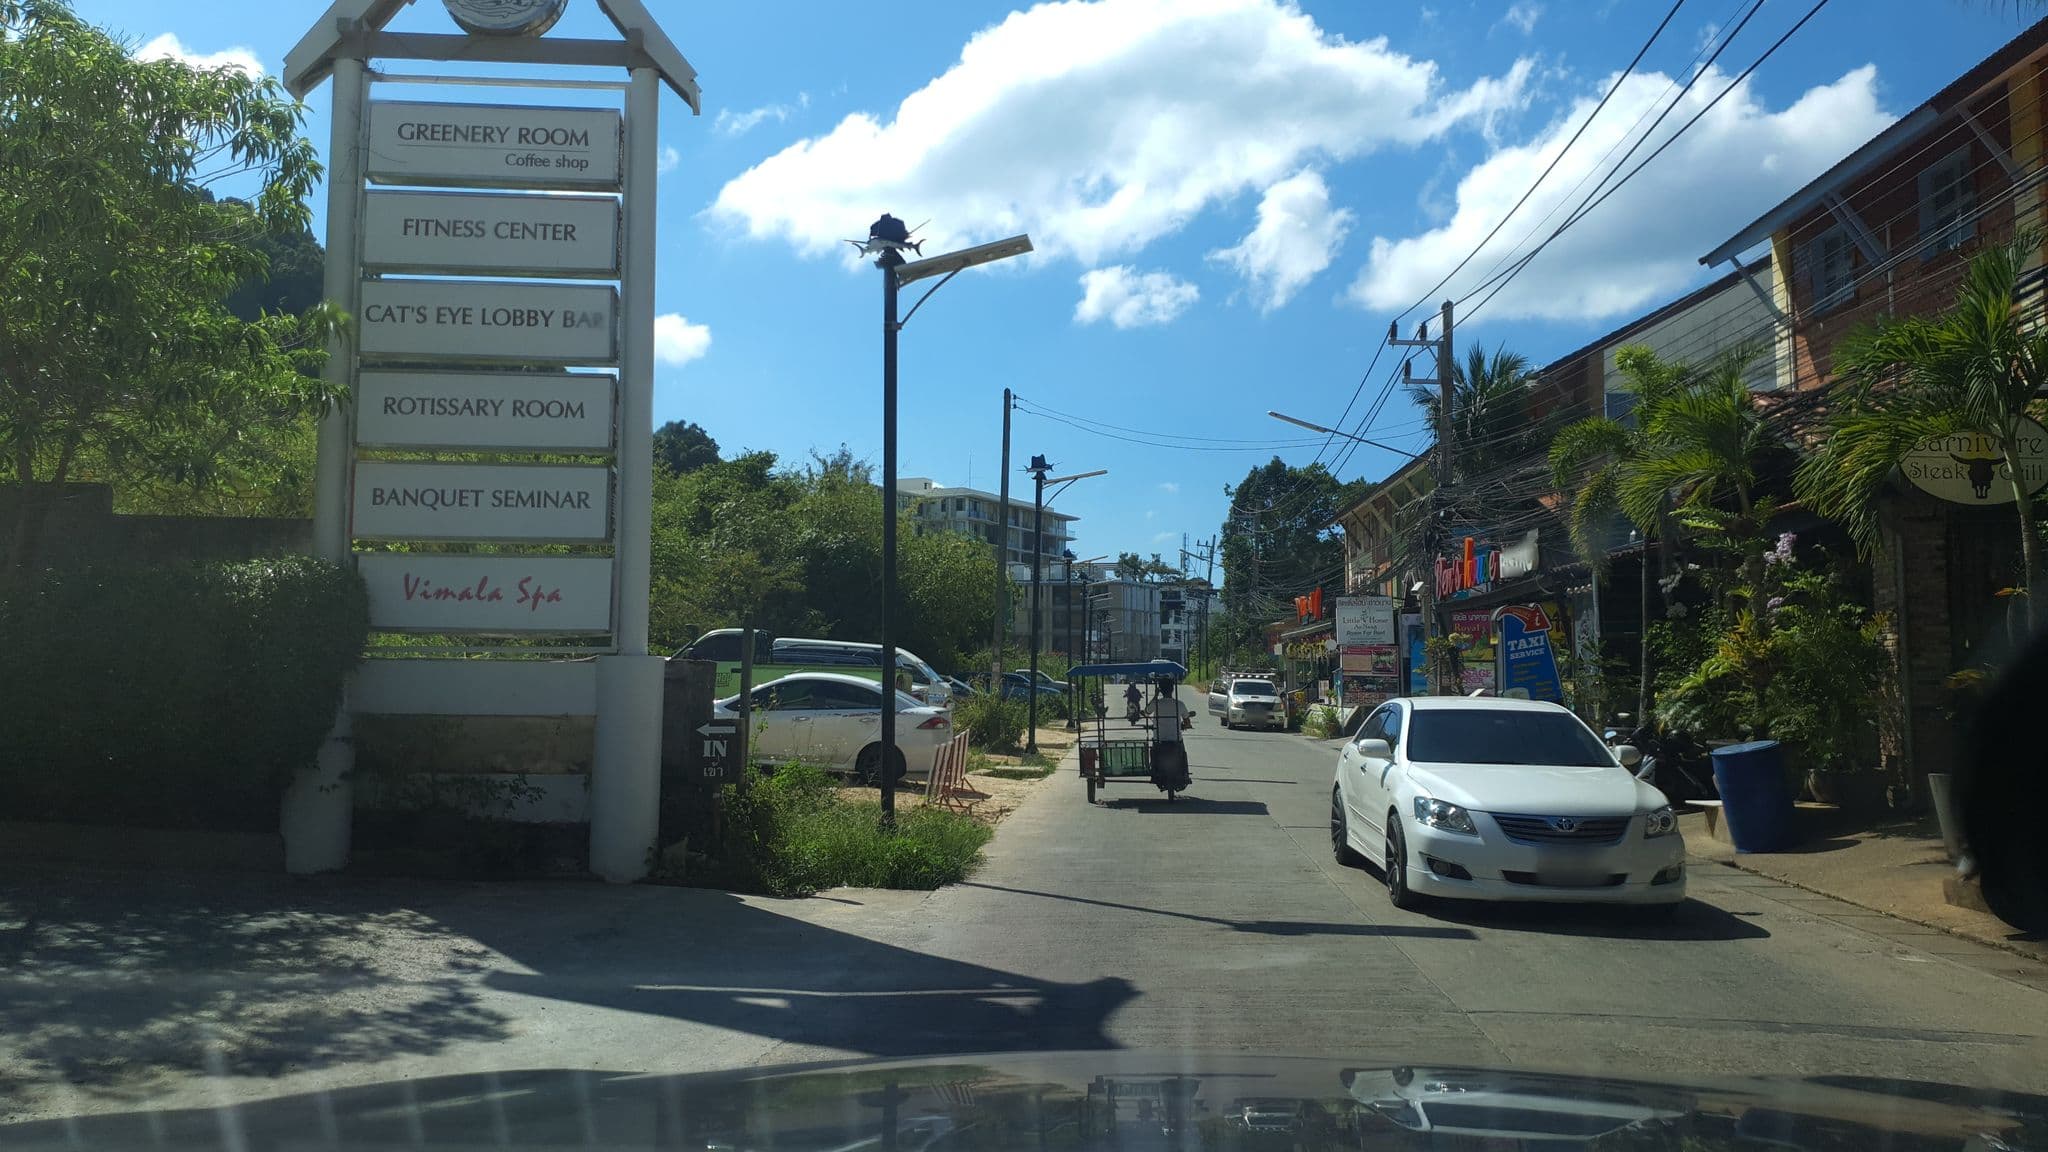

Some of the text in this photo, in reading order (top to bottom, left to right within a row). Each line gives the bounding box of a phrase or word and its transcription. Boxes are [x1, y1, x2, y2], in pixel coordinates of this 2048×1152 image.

[397, 122, 589, 147] GREENERY ROOM
[505, 153, 589, 171] Coffee shop
[403, 218, 576, 242] FITNESS CENTER
[365, 304, 427, 324] CAT'S
[436, 306, 472, 325] EYE
[481, 308, 555, 328] LOBBY
[383, 396, 584, 419] ROTISSARY ROOM
[1909, 461, 1966, 481] Steak
[371, 487, 591, 511] BANQUET SEMINAR
[403, 572, 562, 611] Vimala Spa
[1507, 635, 1545, 651] TAXI
[1510, 648, 1545, 660] SERVICE
[703, 740, 728, 757] IN
